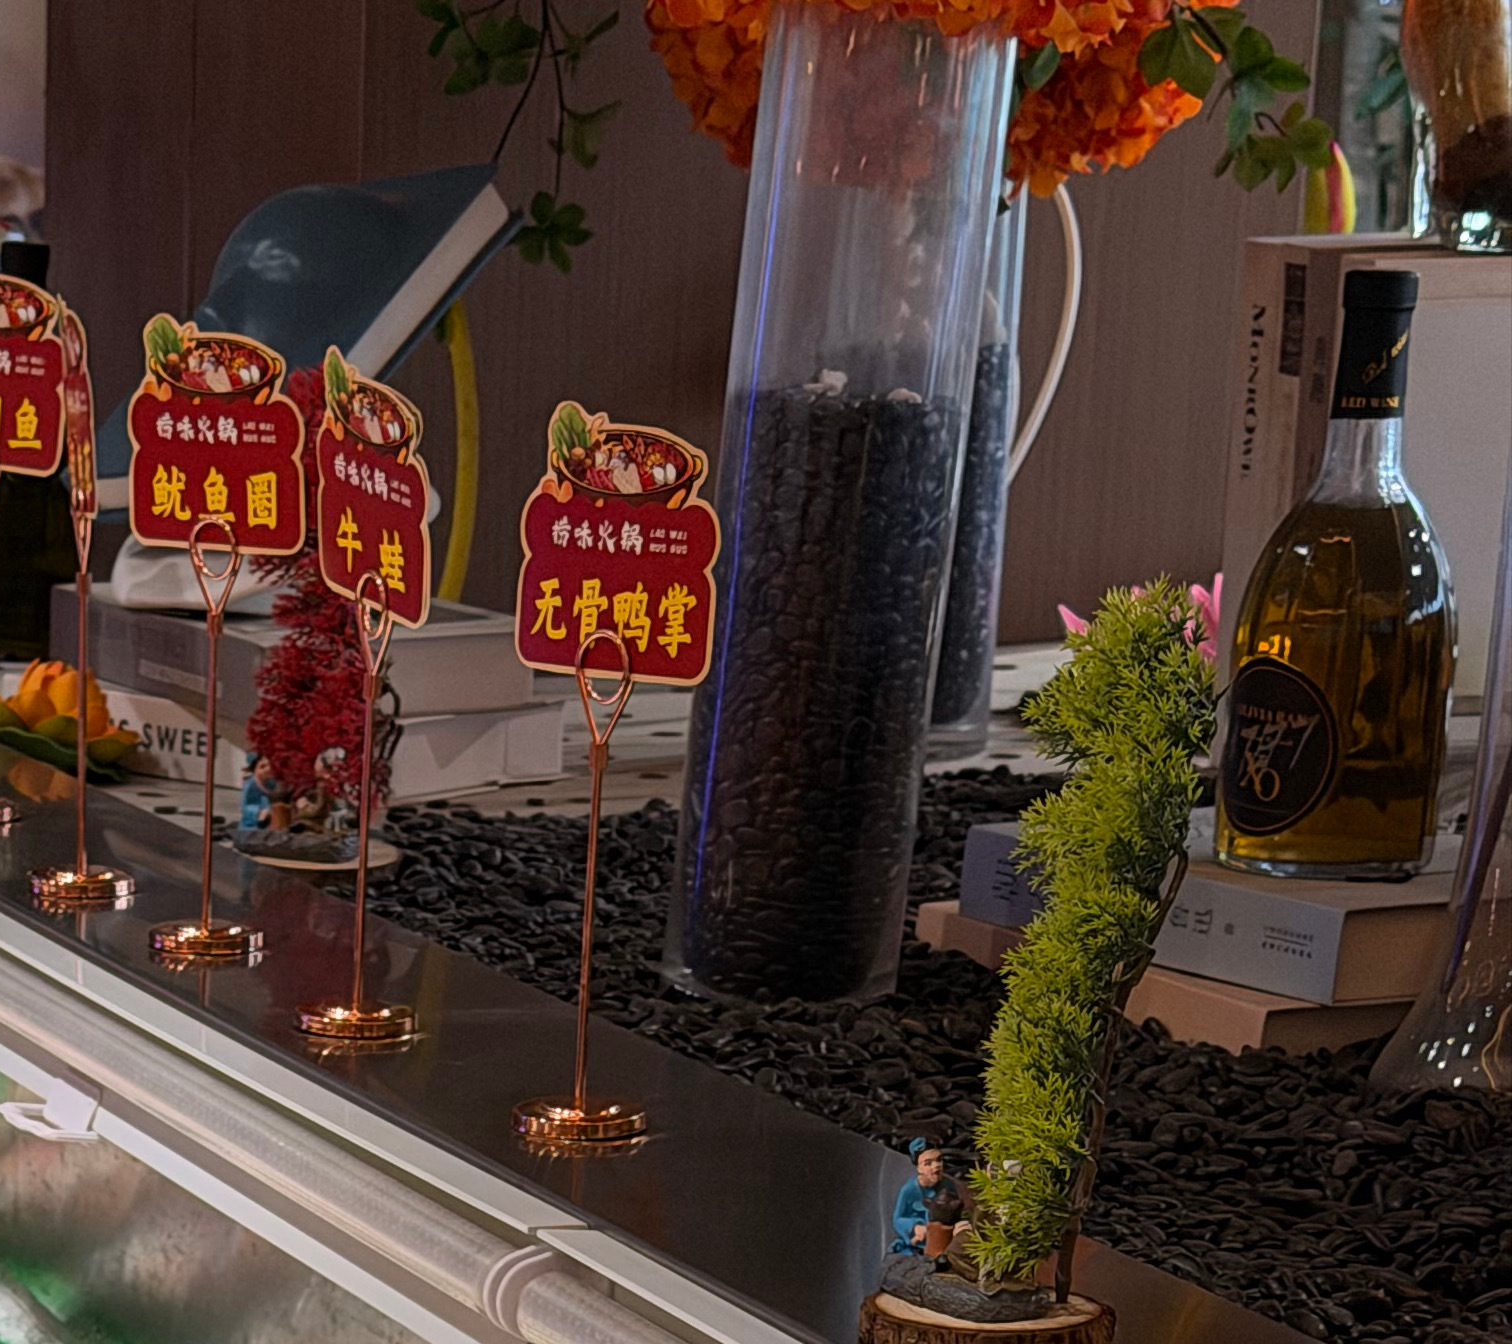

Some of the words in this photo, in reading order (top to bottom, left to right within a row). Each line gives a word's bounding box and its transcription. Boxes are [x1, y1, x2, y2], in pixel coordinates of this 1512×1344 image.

[152, 464, 277, 530] 鱿鱼圈
[336, 506, 406, 593] 牛蛙
[530, 578, 697, 658] 无骨鸭掌
[140, 724, 221, 758] SWEE
